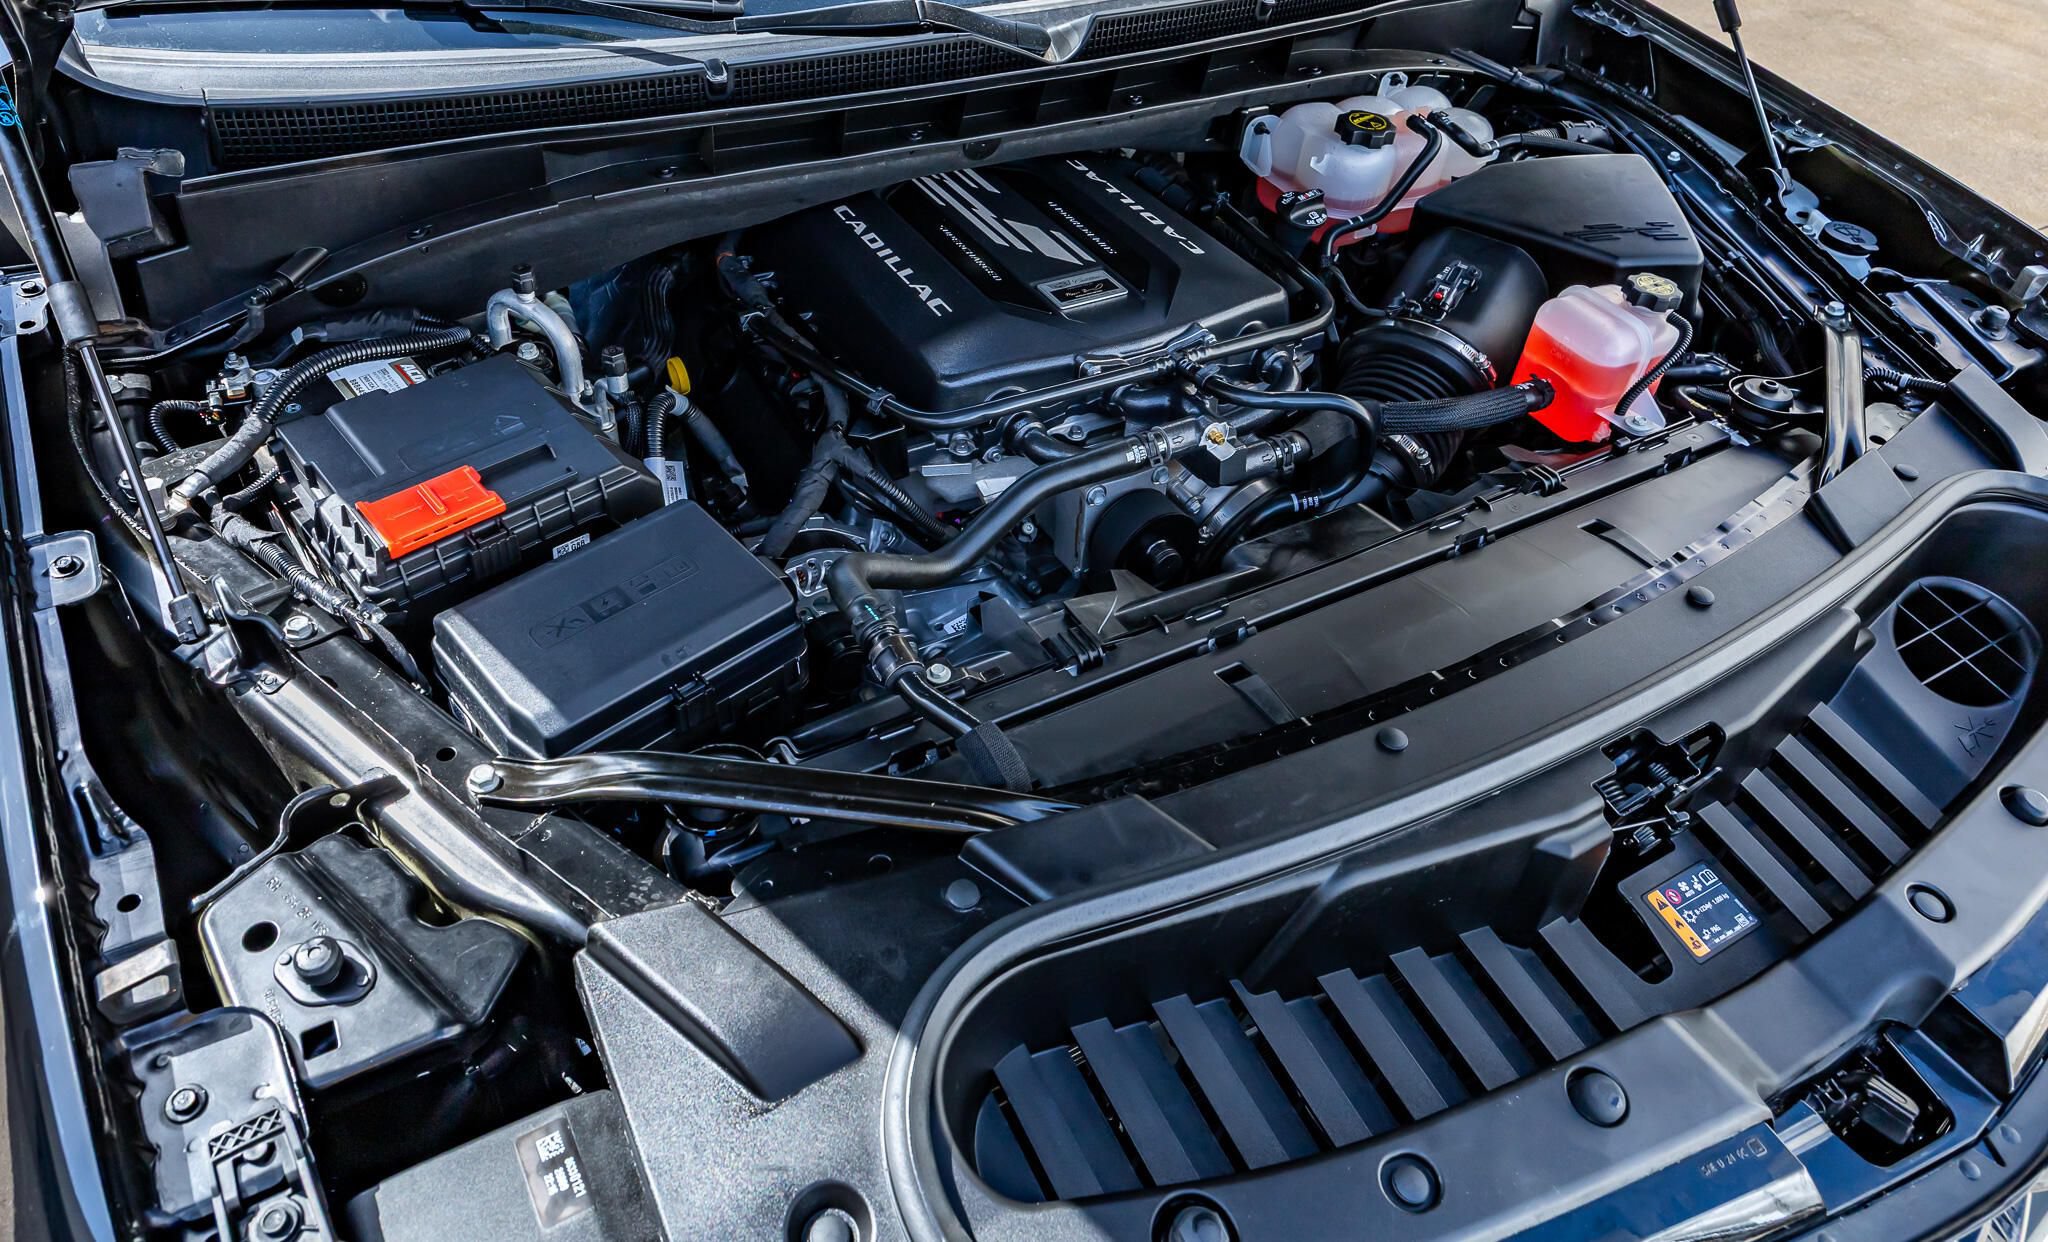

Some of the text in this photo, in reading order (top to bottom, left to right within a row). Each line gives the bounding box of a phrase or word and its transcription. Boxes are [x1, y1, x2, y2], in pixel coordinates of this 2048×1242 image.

[1066, 159, 1205, 254] CADILLAC
[833, 204, 953, 317] CADILLAC
[1710, 924, 1721, 934] PAG
